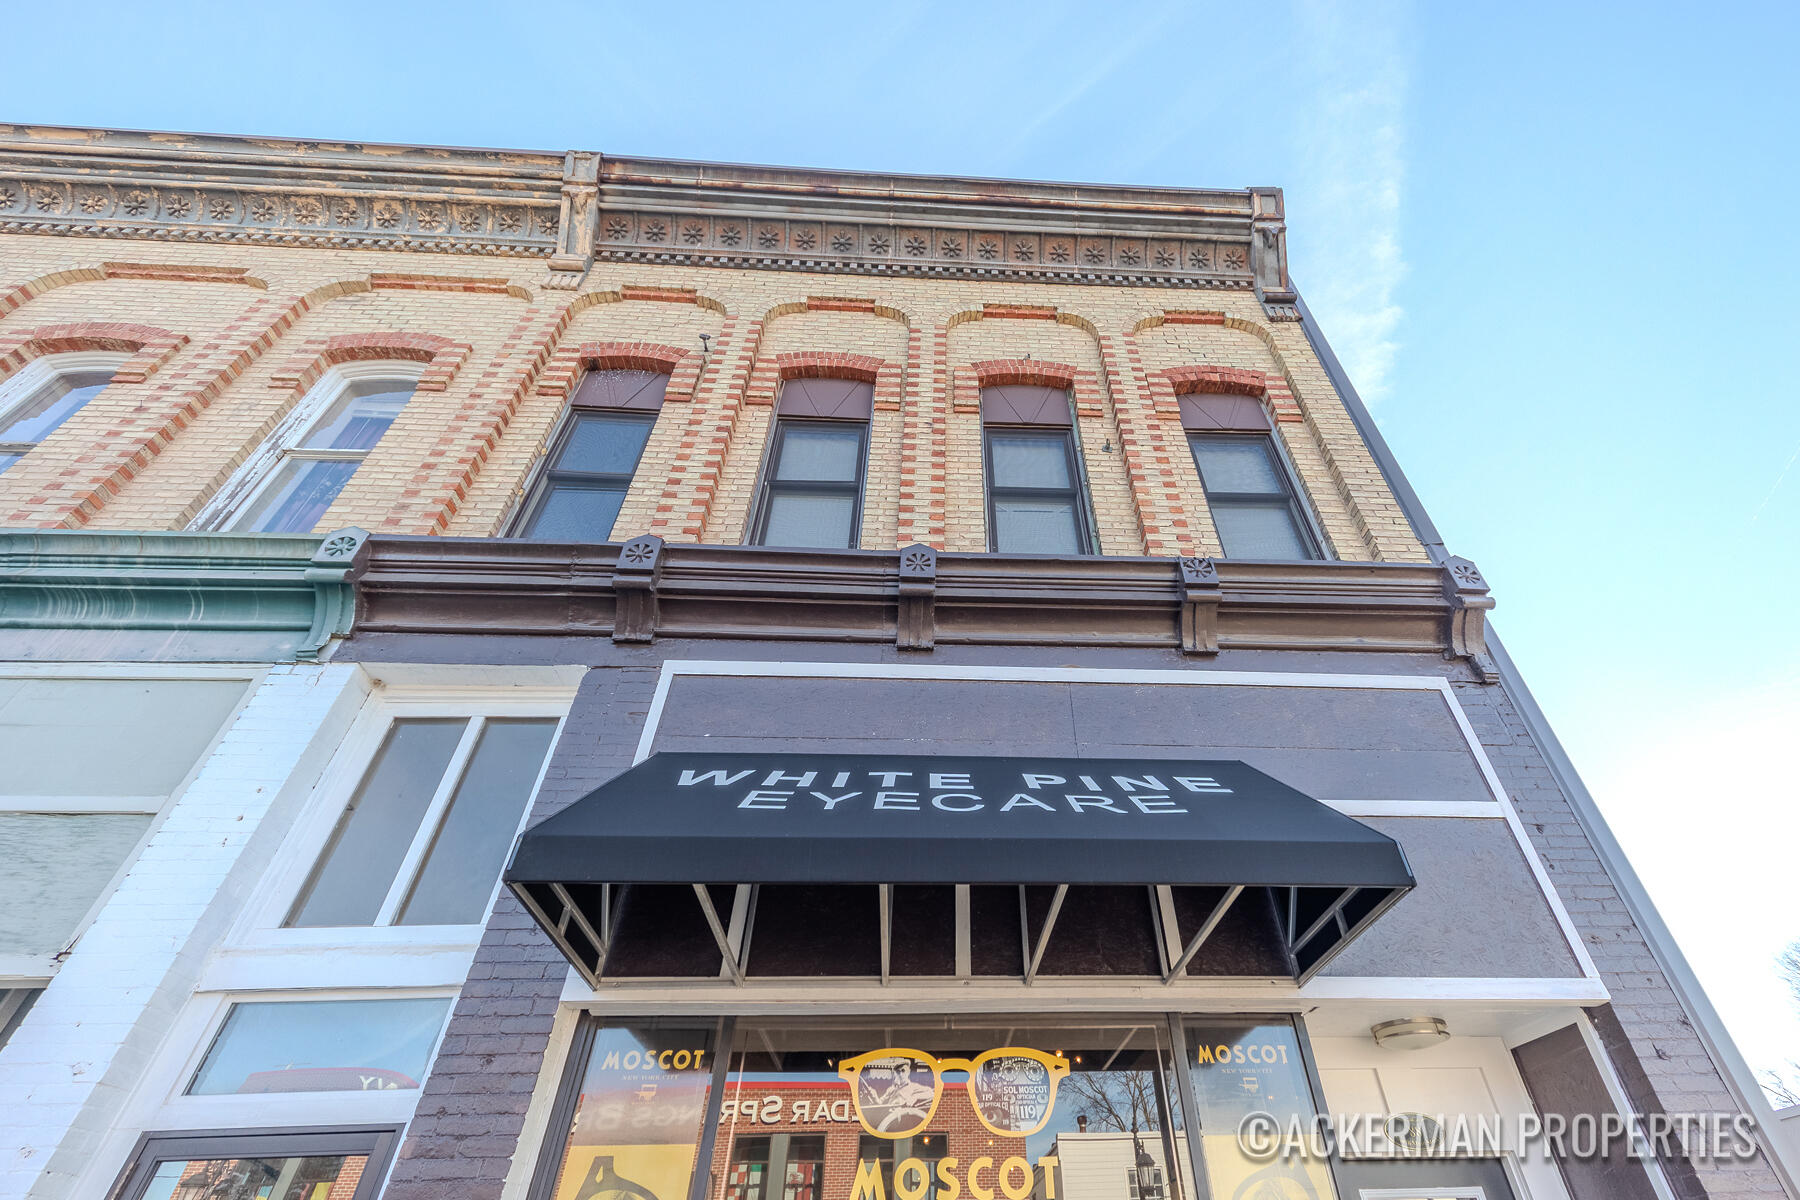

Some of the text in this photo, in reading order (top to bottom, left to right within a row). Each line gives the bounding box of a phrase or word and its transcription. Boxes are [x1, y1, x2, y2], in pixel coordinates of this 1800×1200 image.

[677, 769, 1234, 793] WHITE PINE
[737, 790, 1188, 813] EYECARE
[601, 1049, 704, 1070] MOSCOT
[1198, 1044, 1288, 1064] MOSCOT
[1020, 1105, 1036, 1119] 119
[849, 1156, 1059, 1200] MOSCOT
